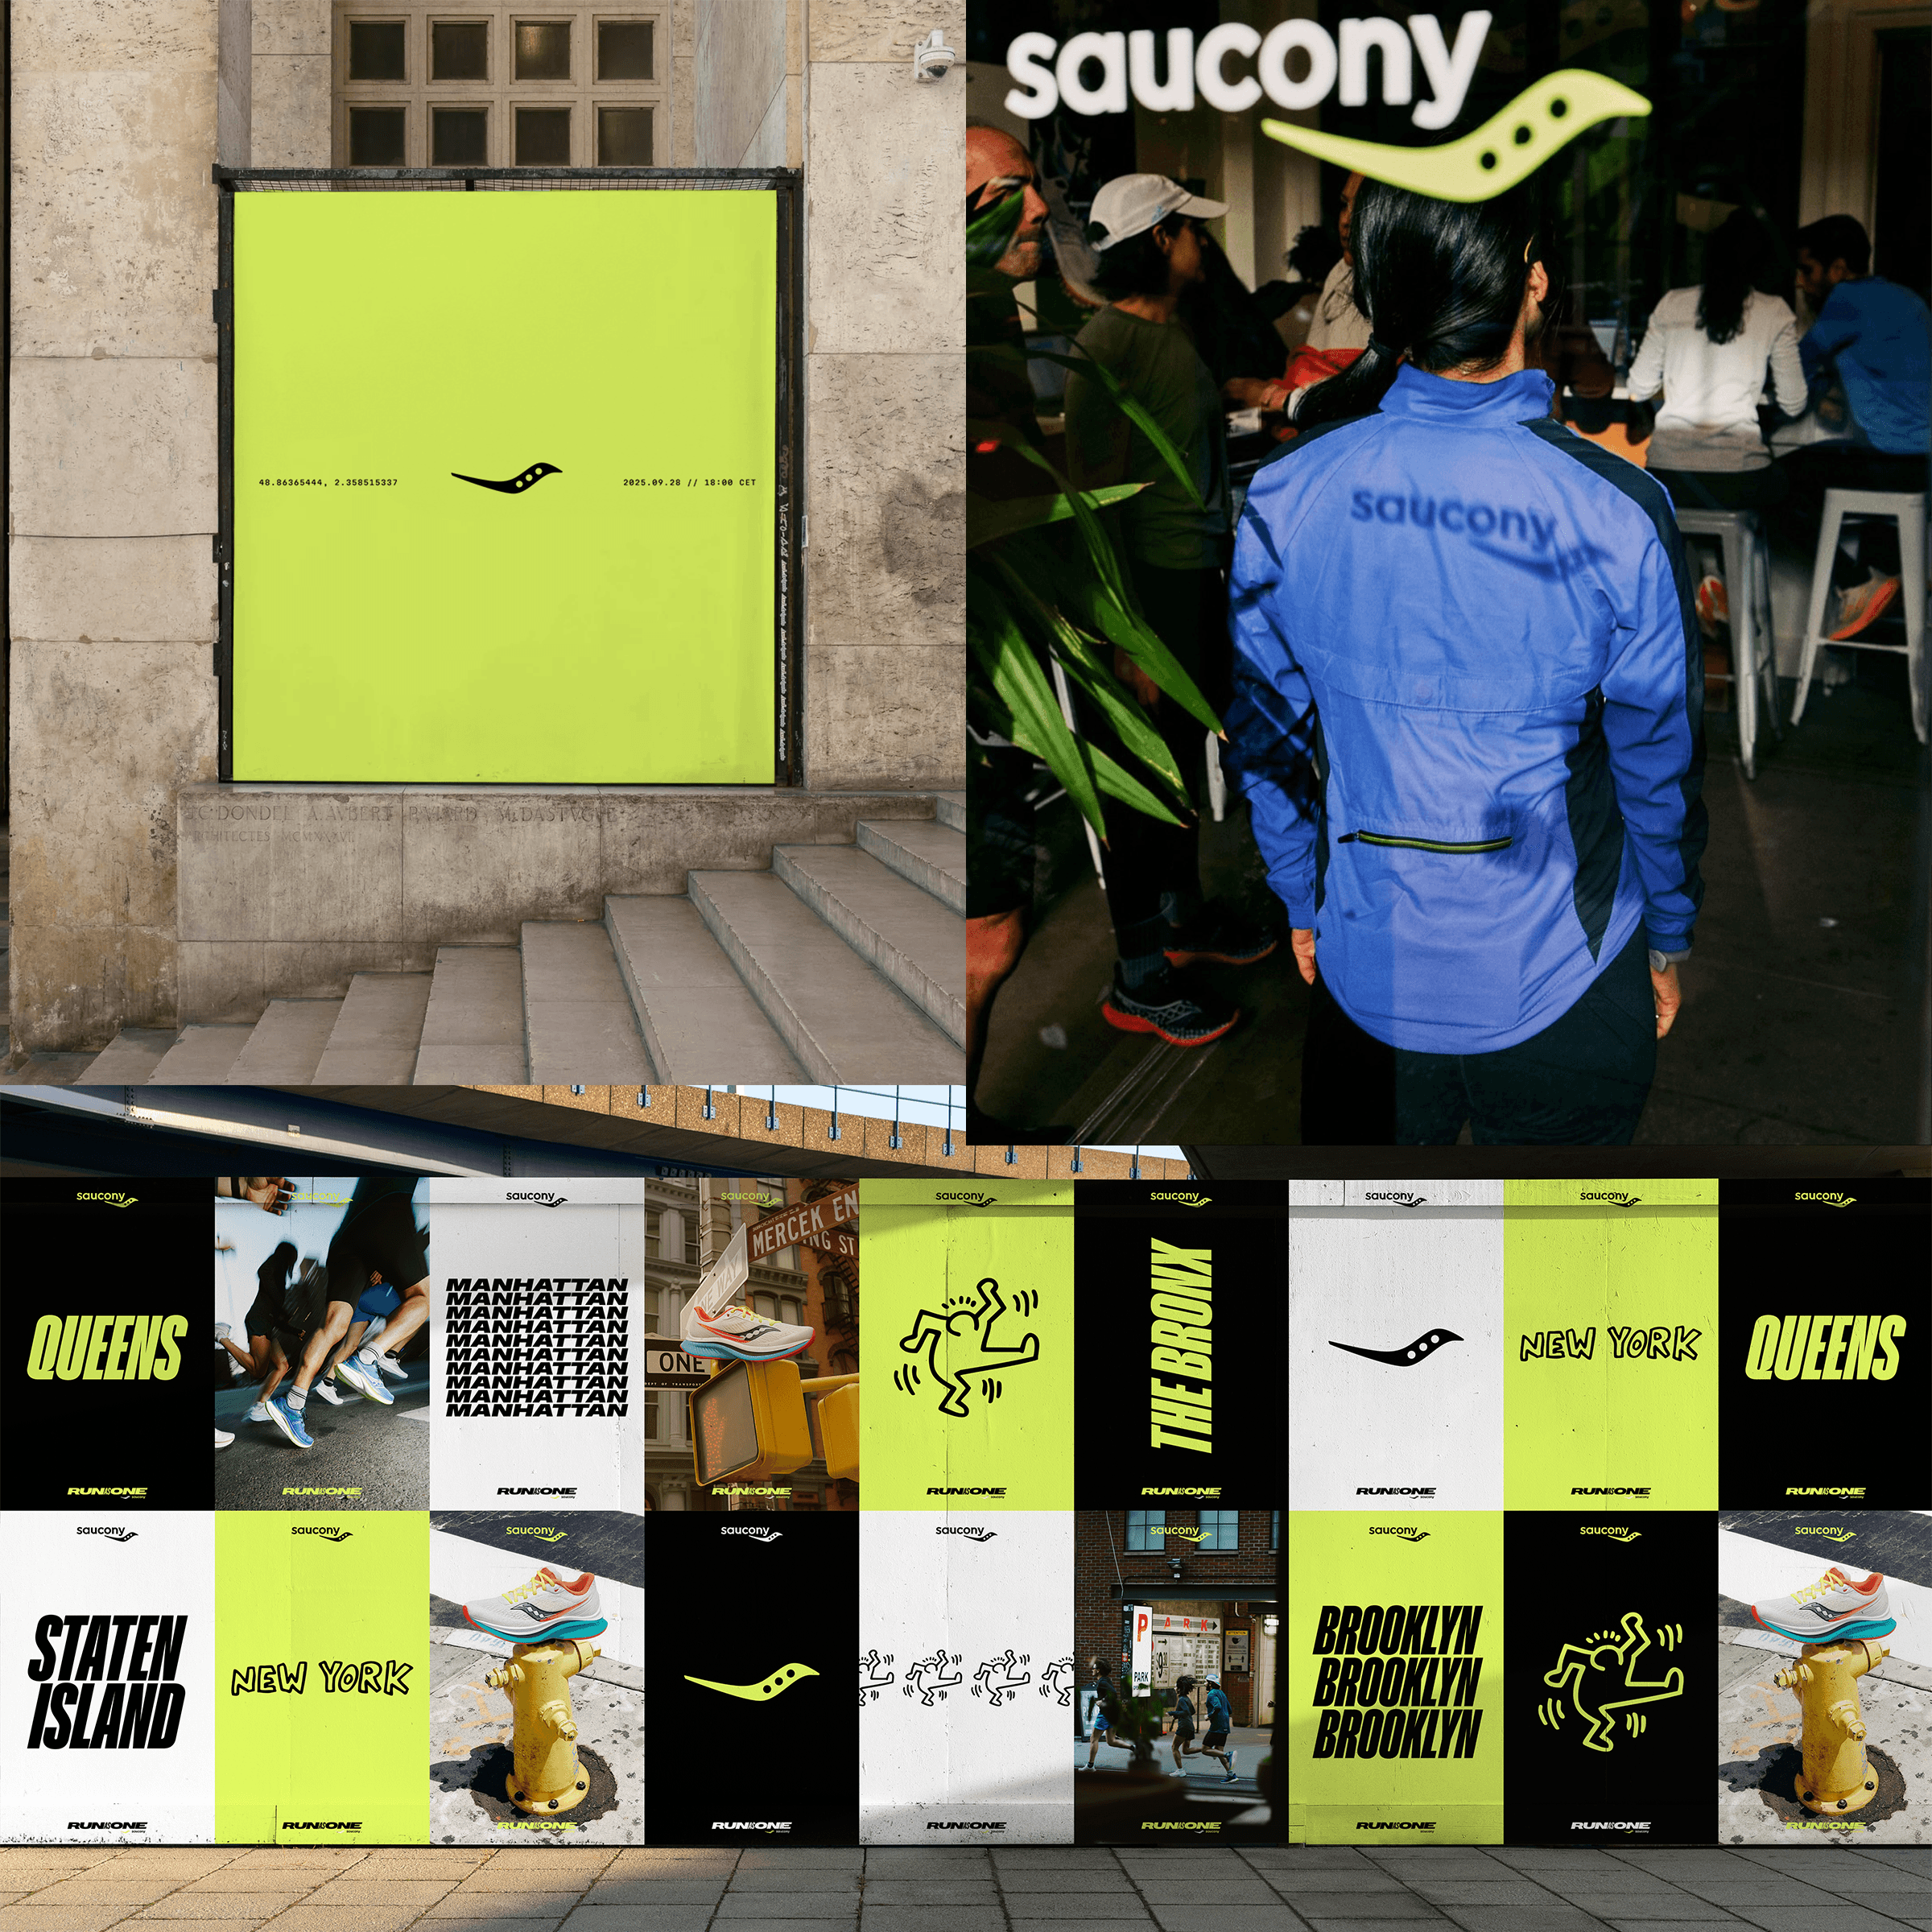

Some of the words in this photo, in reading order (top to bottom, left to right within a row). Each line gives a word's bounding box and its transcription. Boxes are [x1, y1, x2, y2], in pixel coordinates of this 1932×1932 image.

[1004, 10, 1492, 130] saucony
[259, 478, 327, 488] 48.86365444,
[334, 478, 398, 486] 2.358515337
[623, 478, 681, 486] 2025.09.28
[704, 478, 733, 486] 18:00
[739, 478, 757, 486] CET
[1350, 488, 1558, 554] saucony
[76, 1192, 126, 1202] saucony
[291, 1192, 341, 1202] saucony
[506, 1192, 555, 1202] saucony
[721, 1192, 770, 1202] saucony
[935, 1192, 985, 1202] saucony
[1150, 1192, 1199, 1202] saucony
[1365, 1192, 1414, 1202] saucony
[1580, 1192, 1629, 1202] saucony
[1794, 1192, 1843, 1202] saucony
[753, 1204, 824, 1257] MERCEK
[832, 1189, 859, 1222] EN
[839, 1234, 855, 1256] ST
[445, 1278, 629, 1291] MANHATTAN
[445, 1292, 629, 1305] MANHATTAN
[445, 1307, 629, 1319] MANHATTAN
[1150, 1236, 1212, 1382] BRONX
[445, 1320, 629, 1333] MANHATTAN
[445, 1334, 629, 1347] MANHATTAN
[1519, 1327, 1596, 1362] NEW
[1606, 1325, 1703, 1362] YORK
[27, 1315, 188, 1381] QUEENS
[445, 1348, 629, 1360] MANHATTAN
[1745, 1315, 1907, 1381] QUEENS
[445, 1362, 629, 1375] MANHATTAN
[659, 1352, 705, 1373] ONE
[445, 1376, 629, 1389] MANHATTAN
[445, 1389, 629, 1402] MANHATTAN
[445, 1404, 629, 1417] MANHATTAN
[1150, 1377, 1212, 1454] THE
[76, 1526, 126, 1536] saucony
[291, 1526, 341, 1536] saucony
[506, 1526, 555, 1536] saucony
[721, 1526, 770, 1536] saucony
[935, 1526, 985, 1536] saucony
[1150, 1526, 1199, 1536] saucony
[1369, 1526, 1418, 1536] saucony
[1580, 1526, 1629, 1536] saucony
[1794, 1526, 1843, 1536] saucony
[1312, 1604, 1484, 1655] BROOKLYN
[27, 1614, 188, 1682] STATEN
[230, 1661, 308, 1697] NEW
[318, 1660, 414, 1696] YORK
[1133, 1671, 1149, 1682] PARK
[1312, 1657, 1484, 1707] BROOKLYN
[27, 1682, 187, 1750] ISLAND
[1312, 1708, 1484, 1759] BROOKLYN
